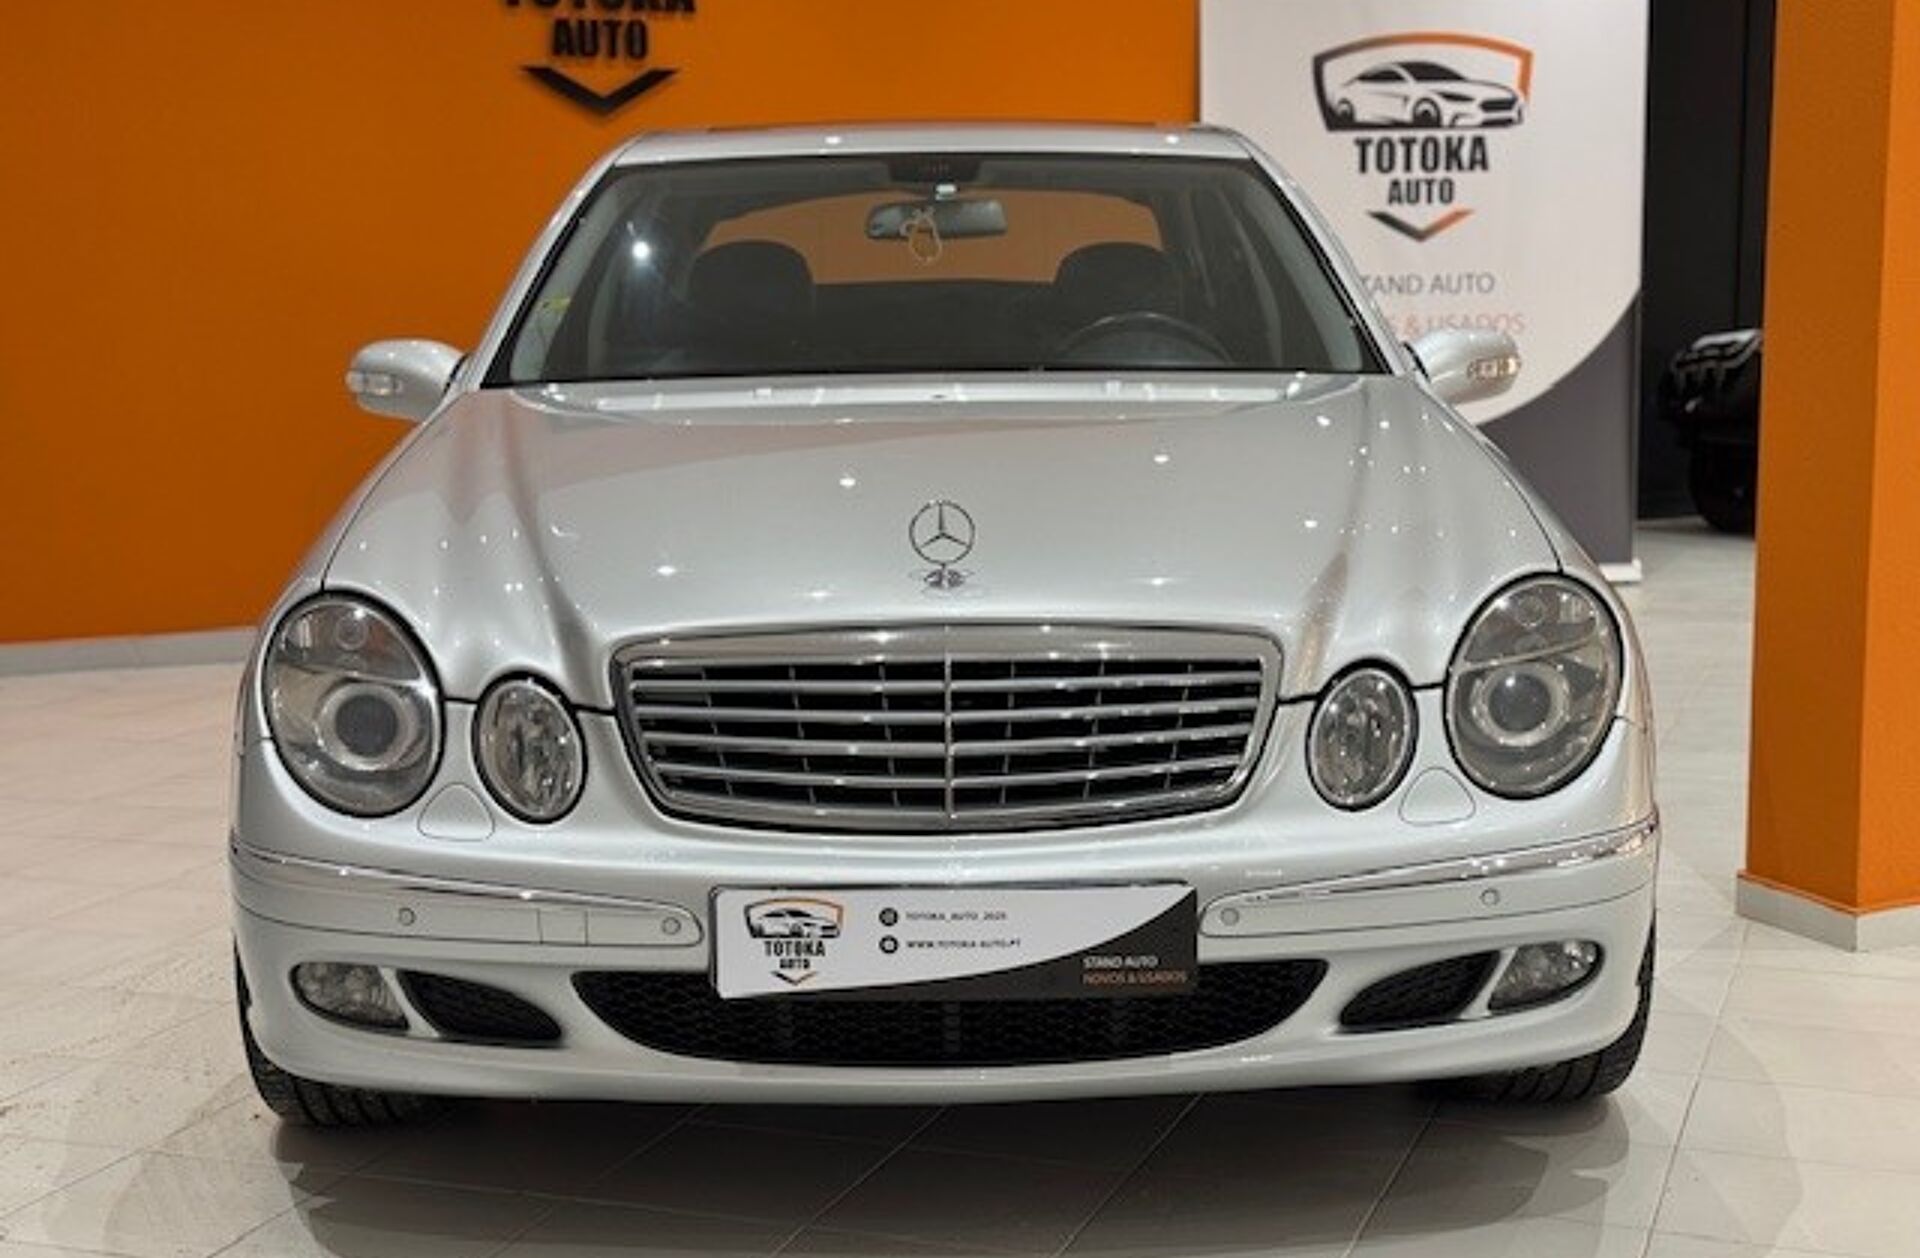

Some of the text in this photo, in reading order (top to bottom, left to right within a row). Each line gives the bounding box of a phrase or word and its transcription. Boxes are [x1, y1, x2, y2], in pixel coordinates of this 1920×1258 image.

[553, 19, 648, 58] AUTO
[1354, 136, 1489, 174] TOTOKA
[1388, 178, 1455, 206] AUTO
[1359, 271, 1496, 295] TAND AUTO
[764, 940, 826, 957] TOTOKA
[779, 958, 811, 969] AUTO
[1083, 955, 1159, 969] STAND AUTO
